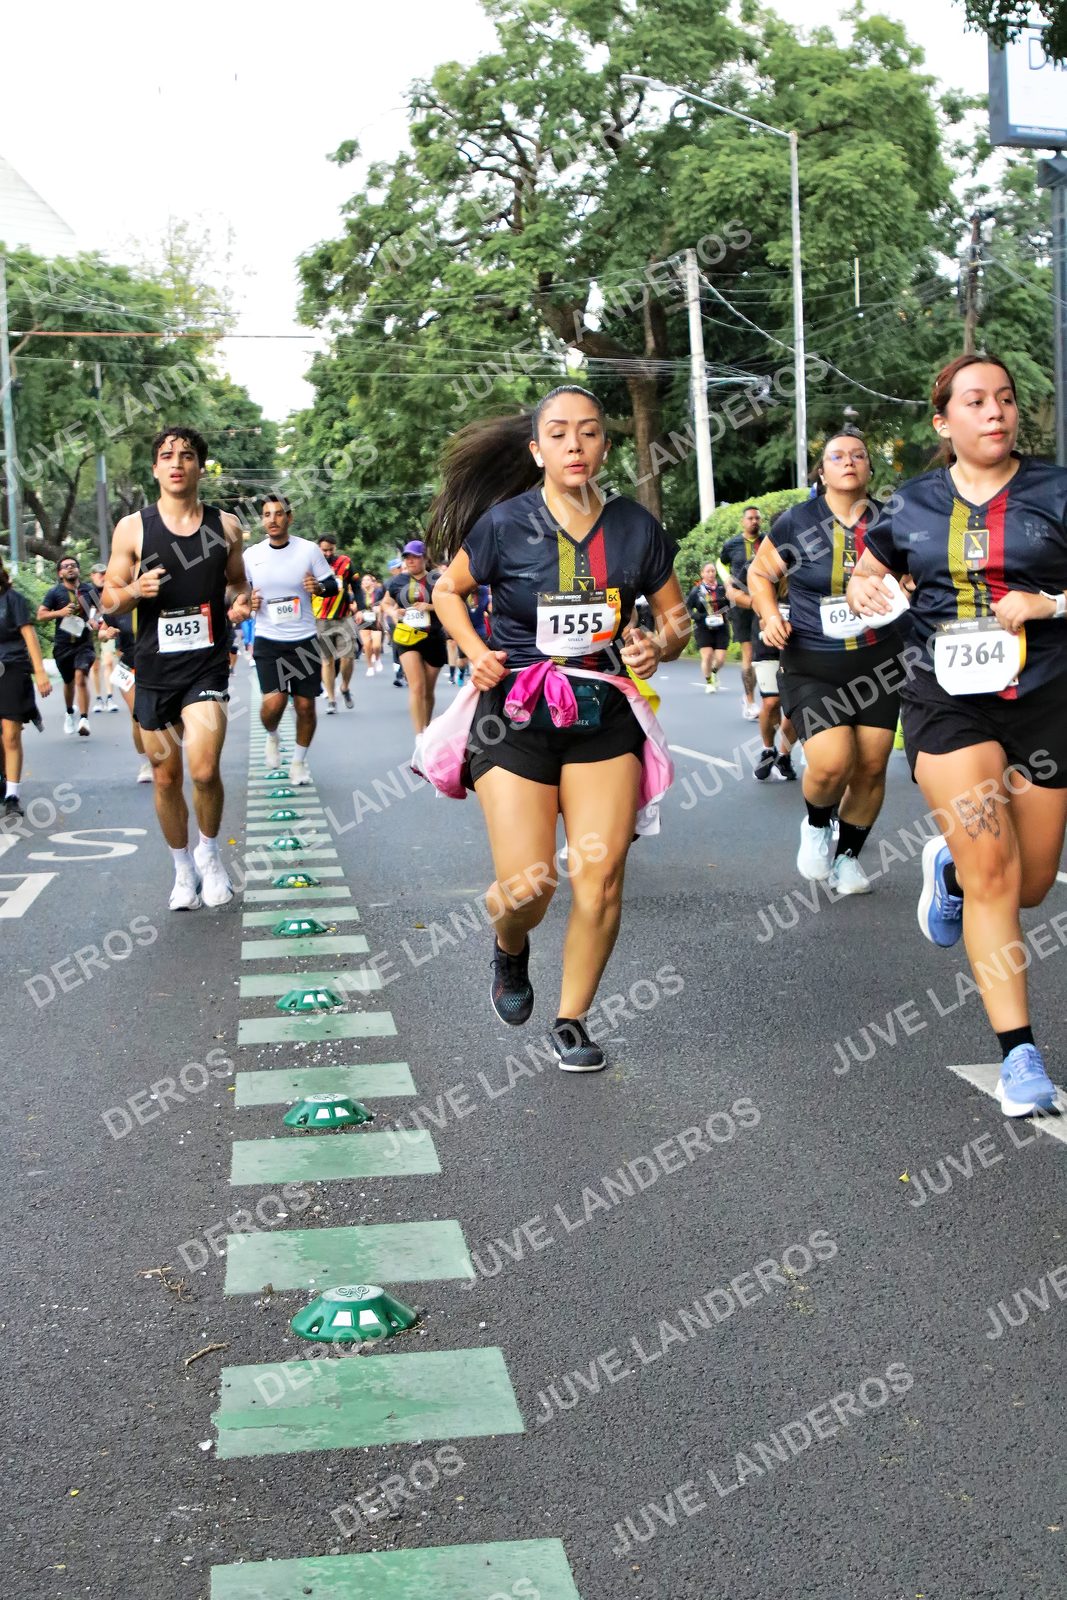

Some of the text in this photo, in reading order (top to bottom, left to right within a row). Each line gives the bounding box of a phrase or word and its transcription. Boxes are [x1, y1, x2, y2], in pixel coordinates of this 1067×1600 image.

[165, 620, 200, 637] 8453
[549, 612, 603, 635] 1555
[945, 640, 1005, 668] 7364
